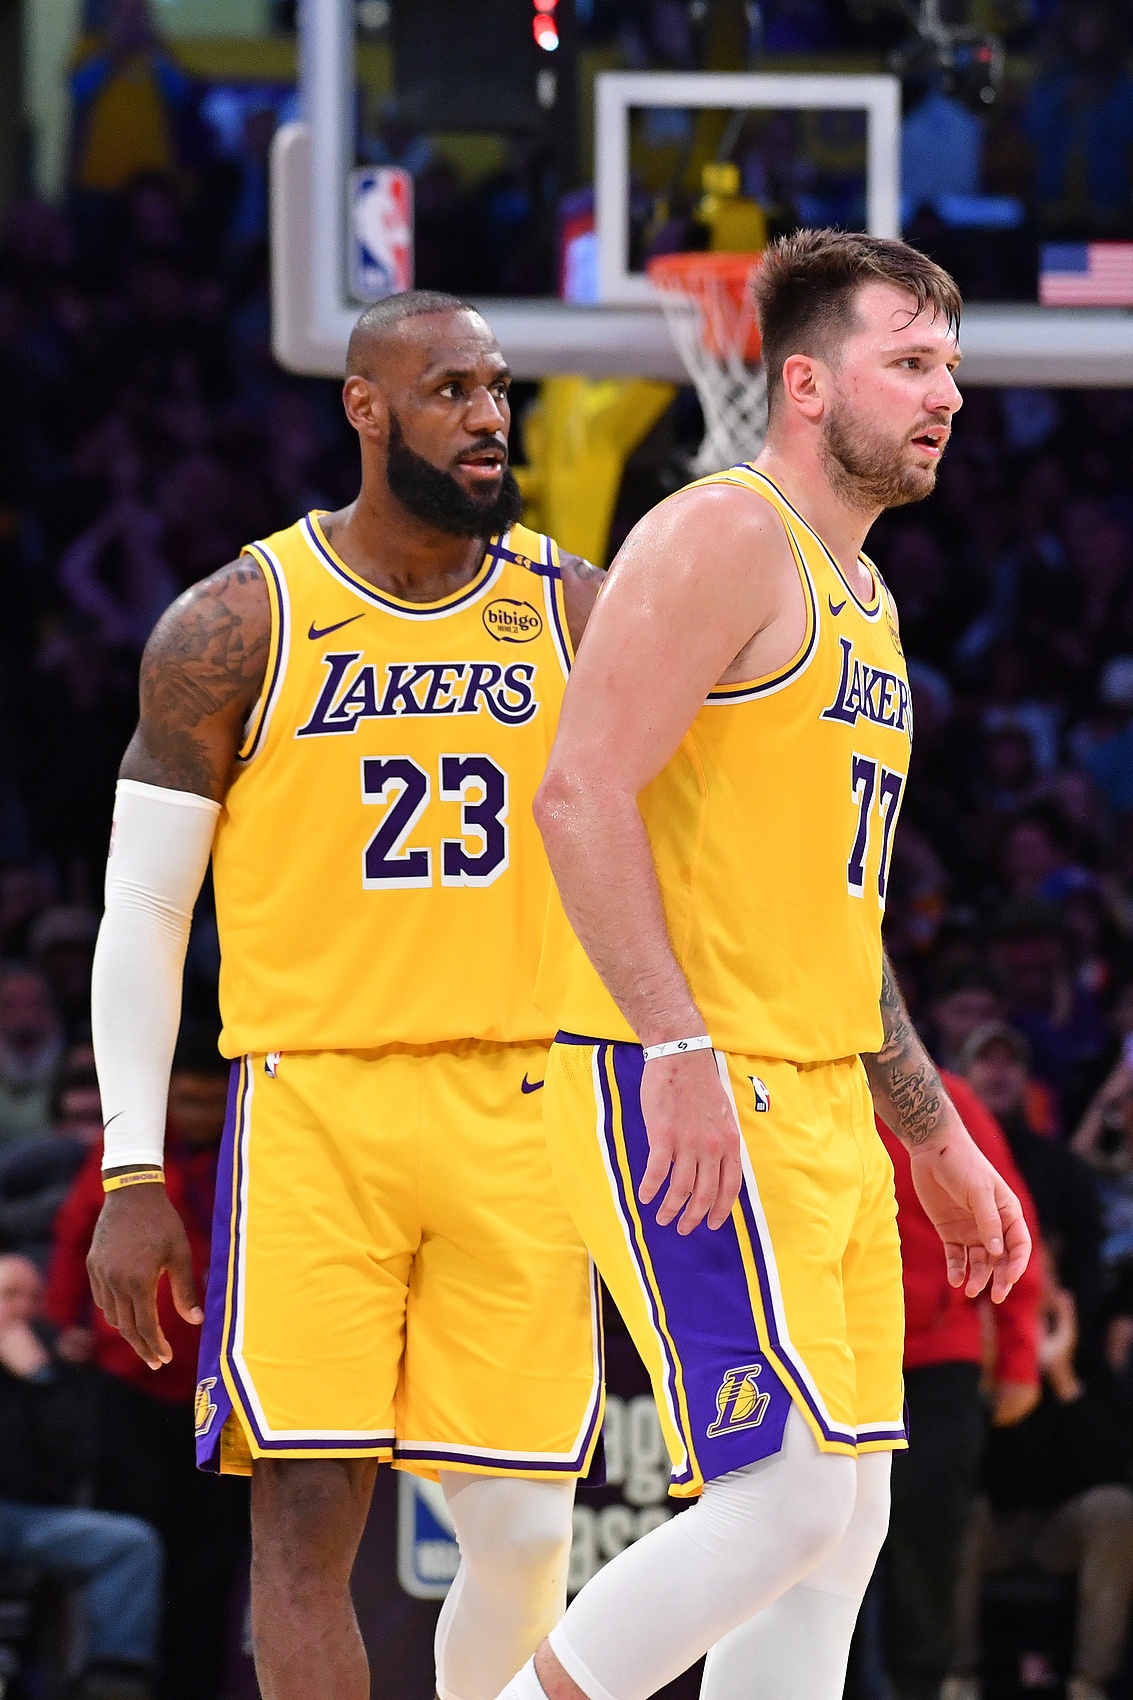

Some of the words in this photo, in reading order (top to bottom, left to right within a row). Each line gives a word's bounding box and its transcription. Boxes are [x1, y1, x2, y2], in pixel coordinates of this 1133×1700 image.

[488, 609, 539, 632] bibigo
[295, 651, 540, 739] LAKERS
[360, 753, 510, 890] 23
[847, 750, 907, 910] 77
